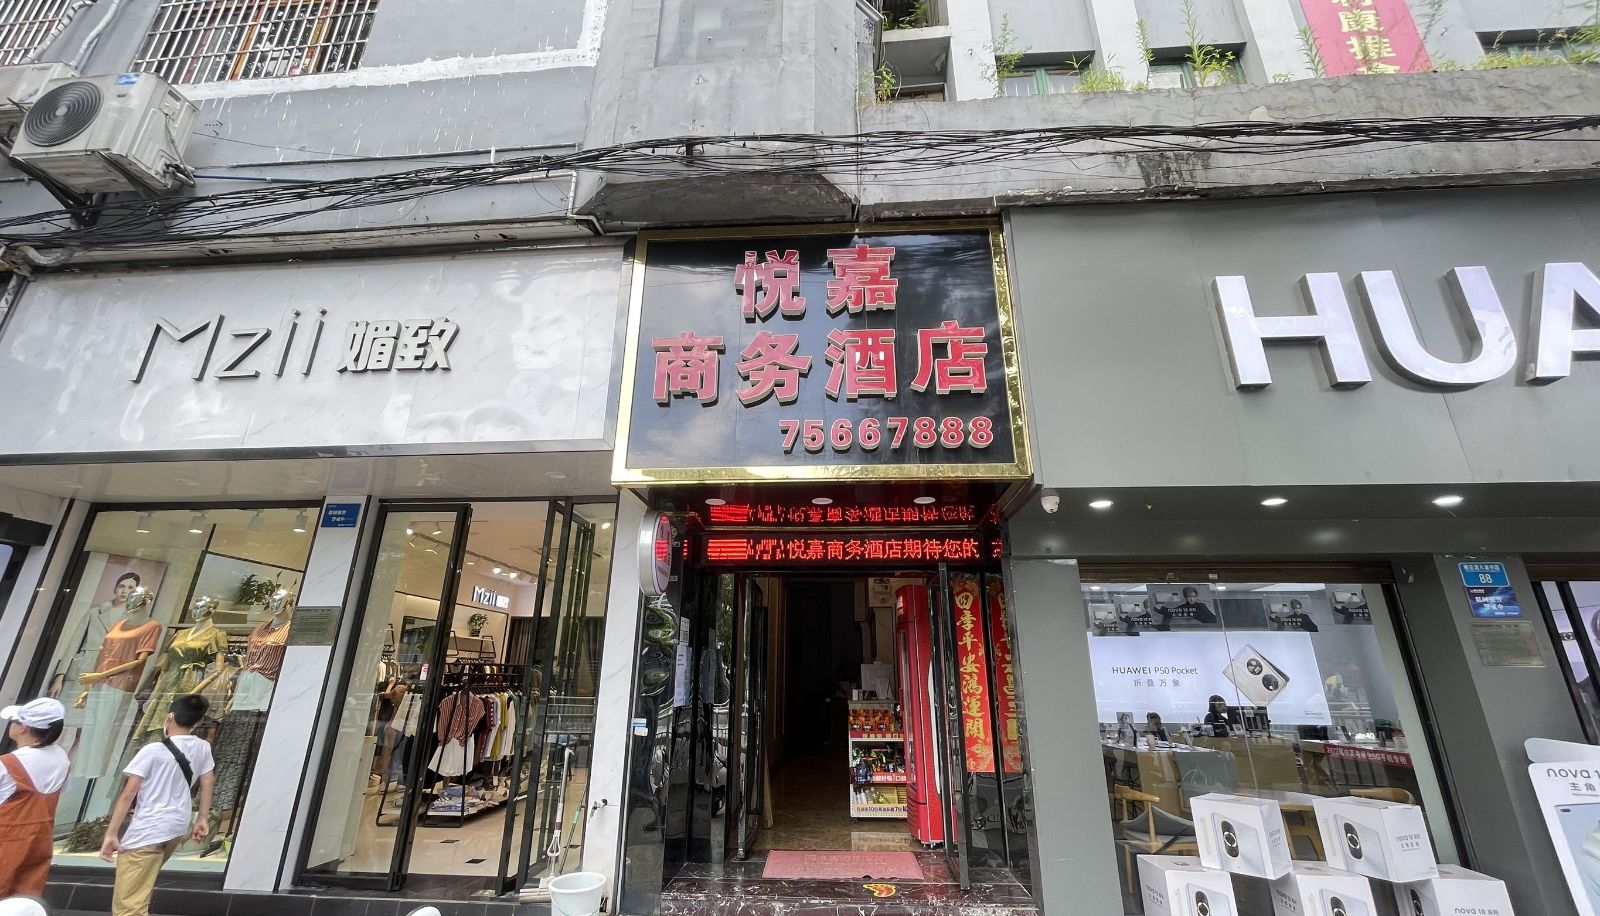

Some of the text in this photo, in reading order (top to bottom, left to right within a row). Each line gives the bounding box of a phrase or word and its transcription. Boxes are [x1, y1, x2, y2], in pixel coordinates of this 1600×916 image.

[734, 244, 899, 321] 悦嘉
[336, 317, 460, 374] 媚致
[651, 320, 989, 407] 商务酒店
[779, 415, 994, 453] 75667888
[1479, 573, 1493, 584] 88
[1112, 667, 1199, 675] HUAWEI P50 Pocket
[1546, 768, 1592, 779] nova
[1454, 907, 1477, 915] nova
